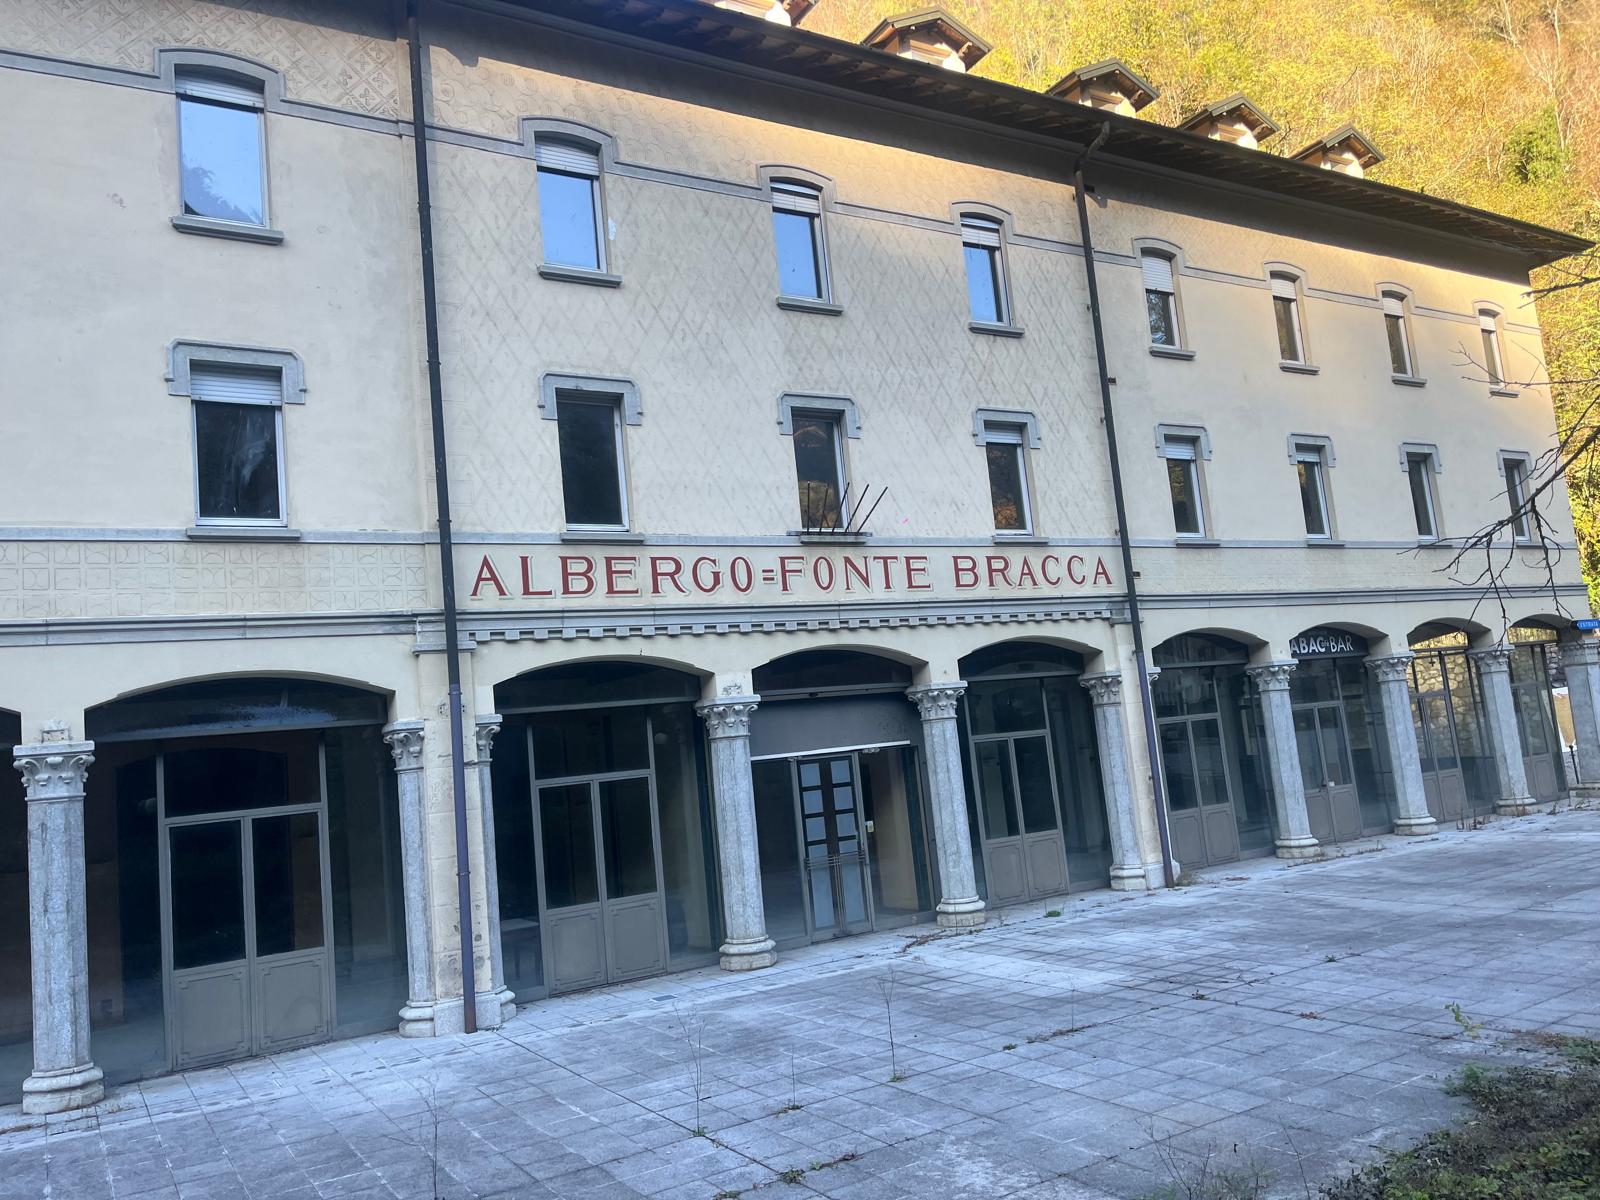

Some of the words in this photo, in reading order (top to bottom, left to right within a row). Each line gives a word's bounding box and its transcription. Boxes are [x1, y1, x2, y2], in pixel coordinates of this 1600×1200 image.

[952, 555, 1113, 588] BRACCA
[1291, 637, 1325, 653] ABAC
[1330, 635, 1353, 652] BAR
